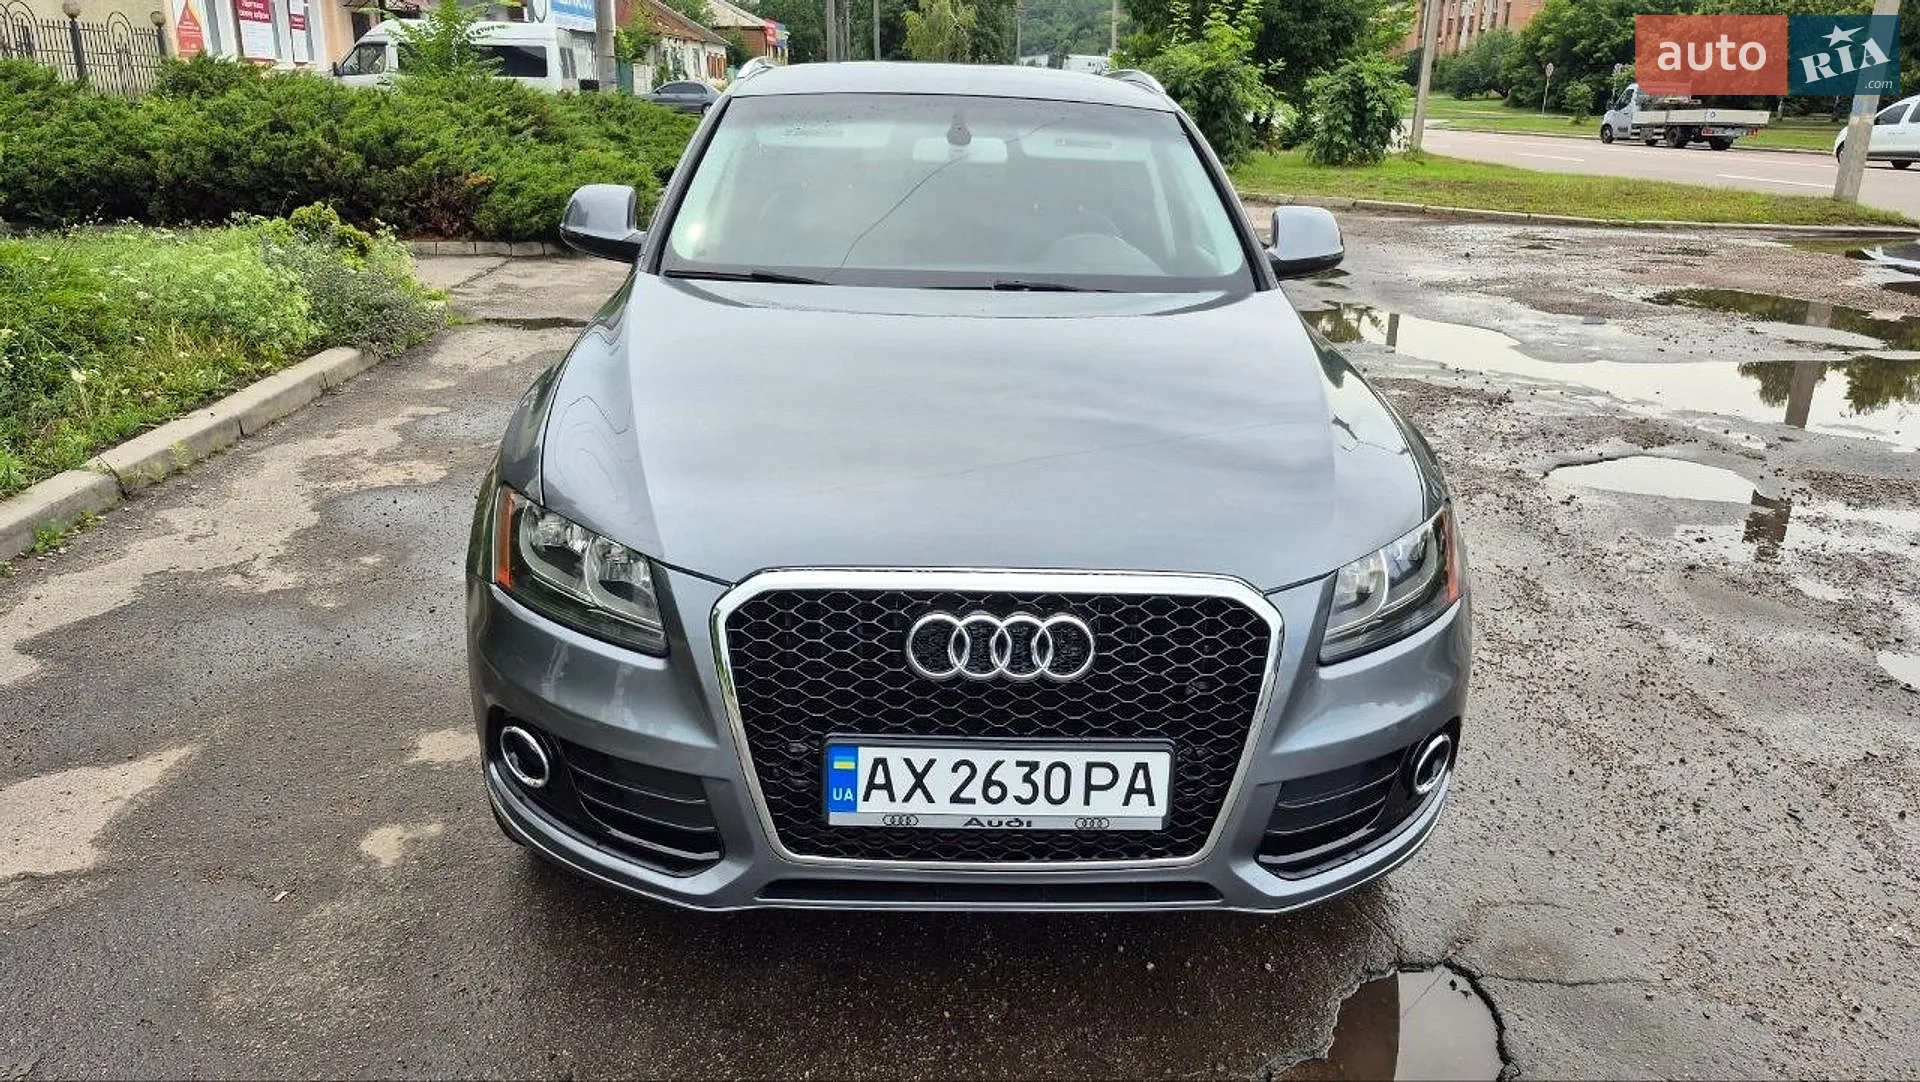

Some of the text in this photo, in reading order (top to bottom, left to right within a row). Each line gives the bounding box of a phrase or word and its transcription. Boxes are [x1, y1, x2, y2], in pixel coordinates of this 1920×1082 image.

[832, 787, 854, 801] UA
[862, 757, 1156, 807] AX 2630 PA
